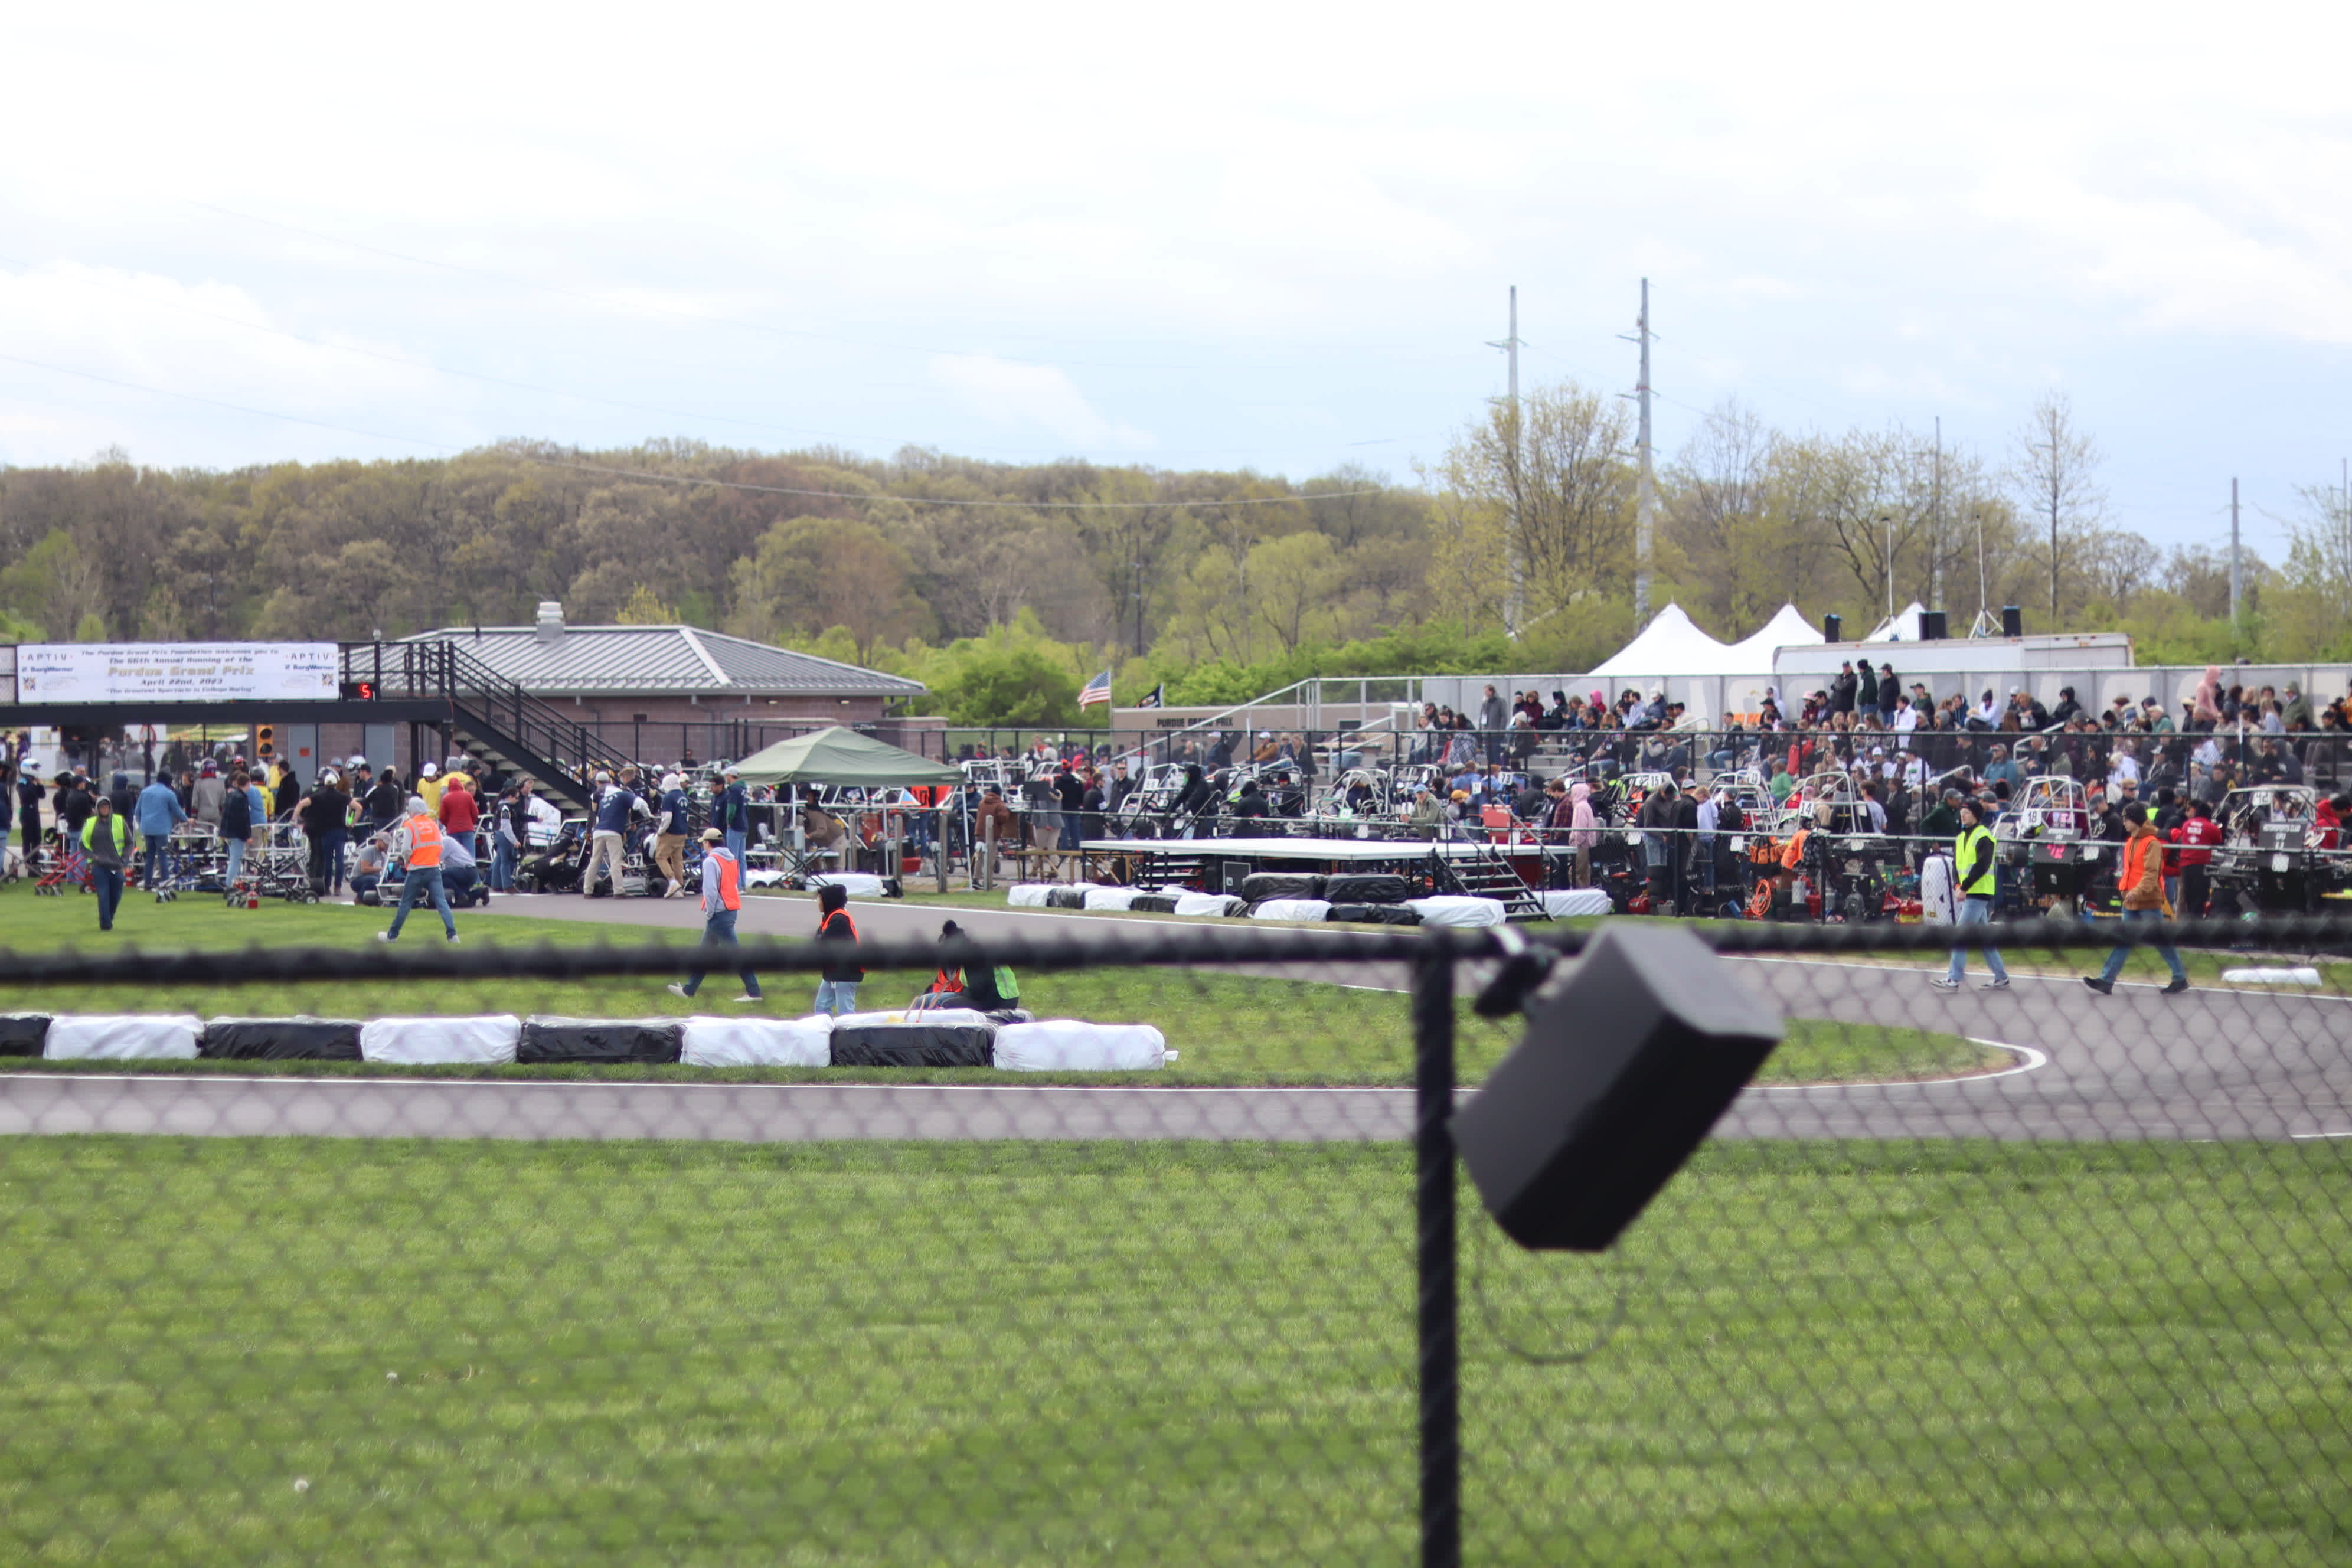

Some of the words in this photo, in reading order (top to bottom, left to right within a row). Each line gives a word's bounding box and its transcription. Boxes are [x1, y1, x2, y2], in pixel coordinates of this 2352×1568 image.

[27, 652, 67, 661] APTIV
[291, 652, 329, 661] APTIV
[107, 667, 162, 676] Purdue
[169, 666, 216, 676] Grand
[222, 665, 255, 676] Prix
[1157, 718, 1185, 728] PURDUE
[1216, 717, 1233, 726] PRIX
[628, 855, 642, 867] 57
